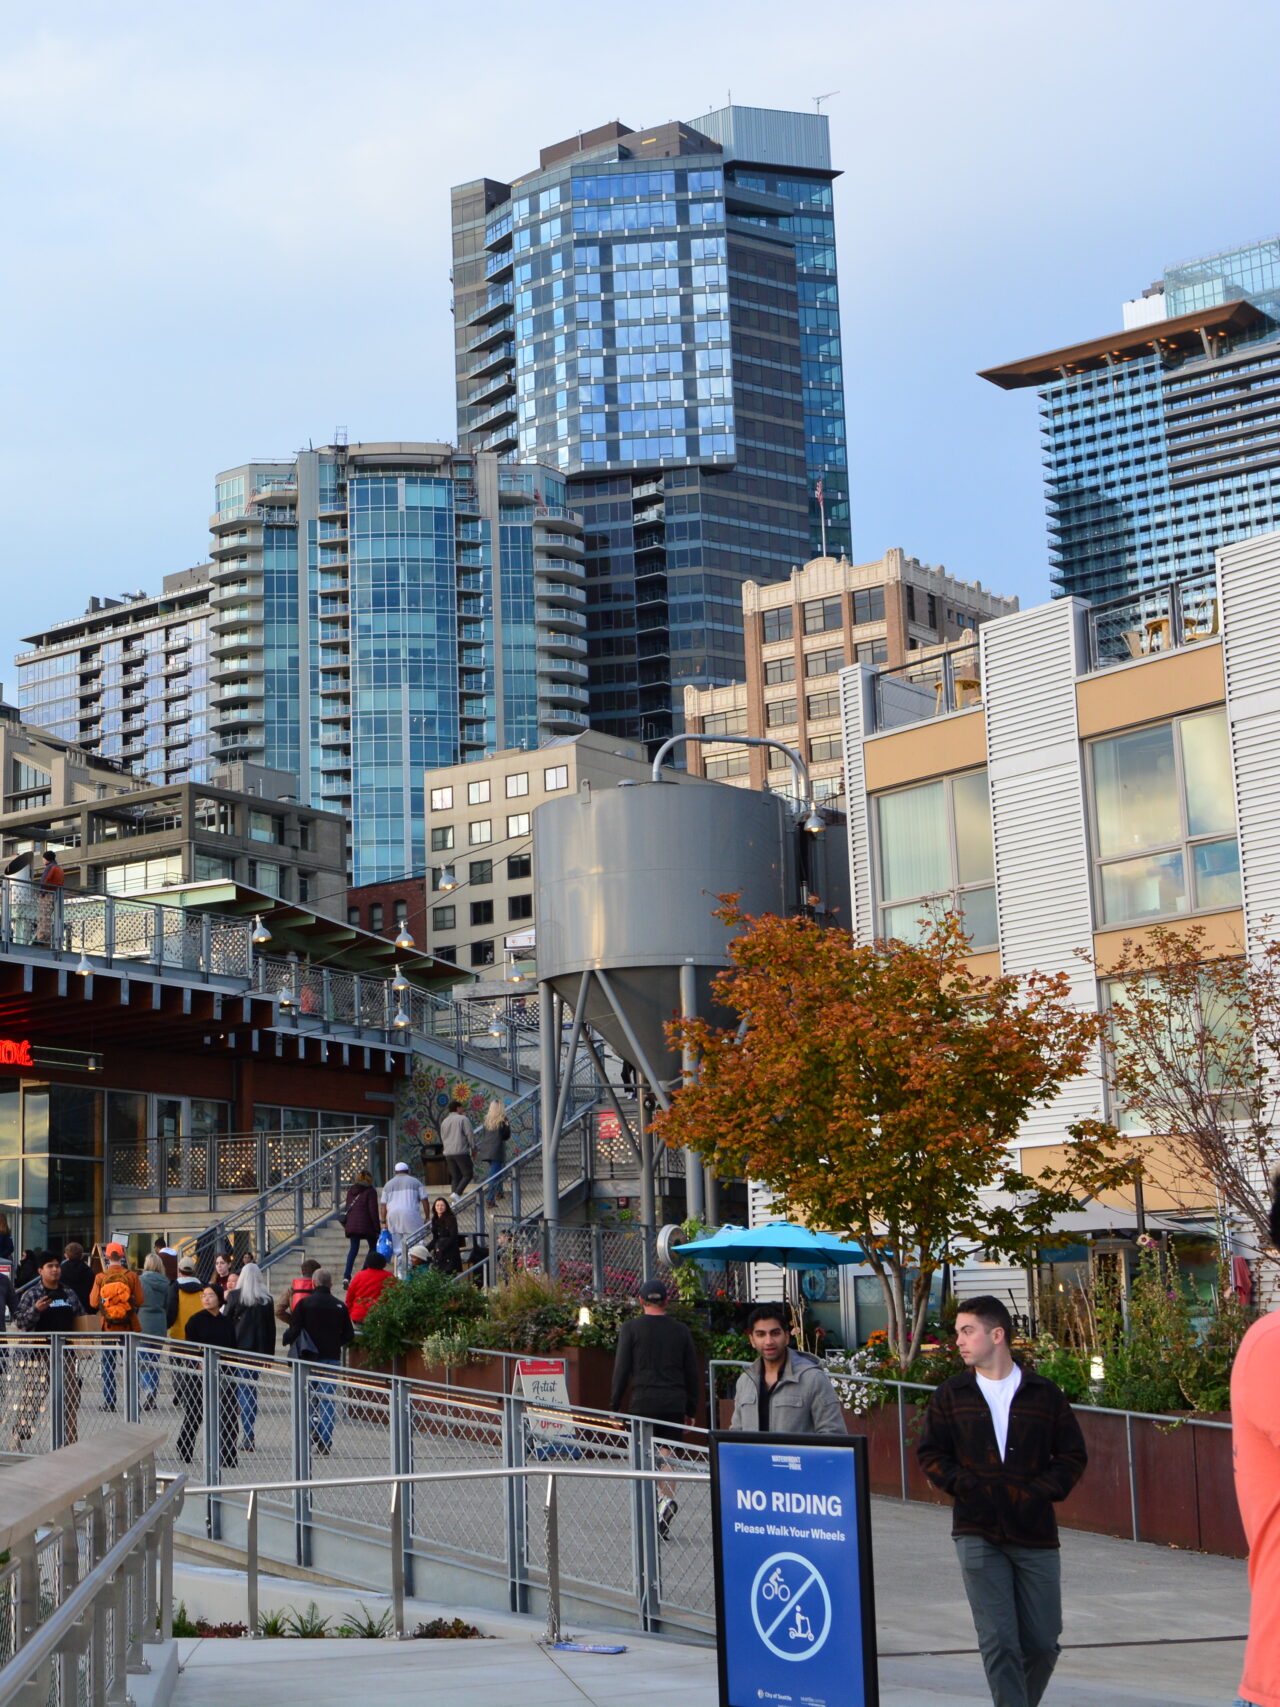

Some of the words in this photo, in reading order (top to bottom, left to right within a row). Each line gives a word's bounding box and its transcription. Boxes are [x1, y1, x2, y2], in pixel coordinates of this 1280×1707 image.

[532, 1380, 558, 1395] Artist
[736, 1489, 767, 1511] NO
[771, 1491, 842, 1517] RIDING
[734, 1522, 765, 1535] Please
[766, 1524, 789, 1537] Walk
[789, 1526, 810, 1539] Your
[810, 1528, 846, 1542] Wheels
